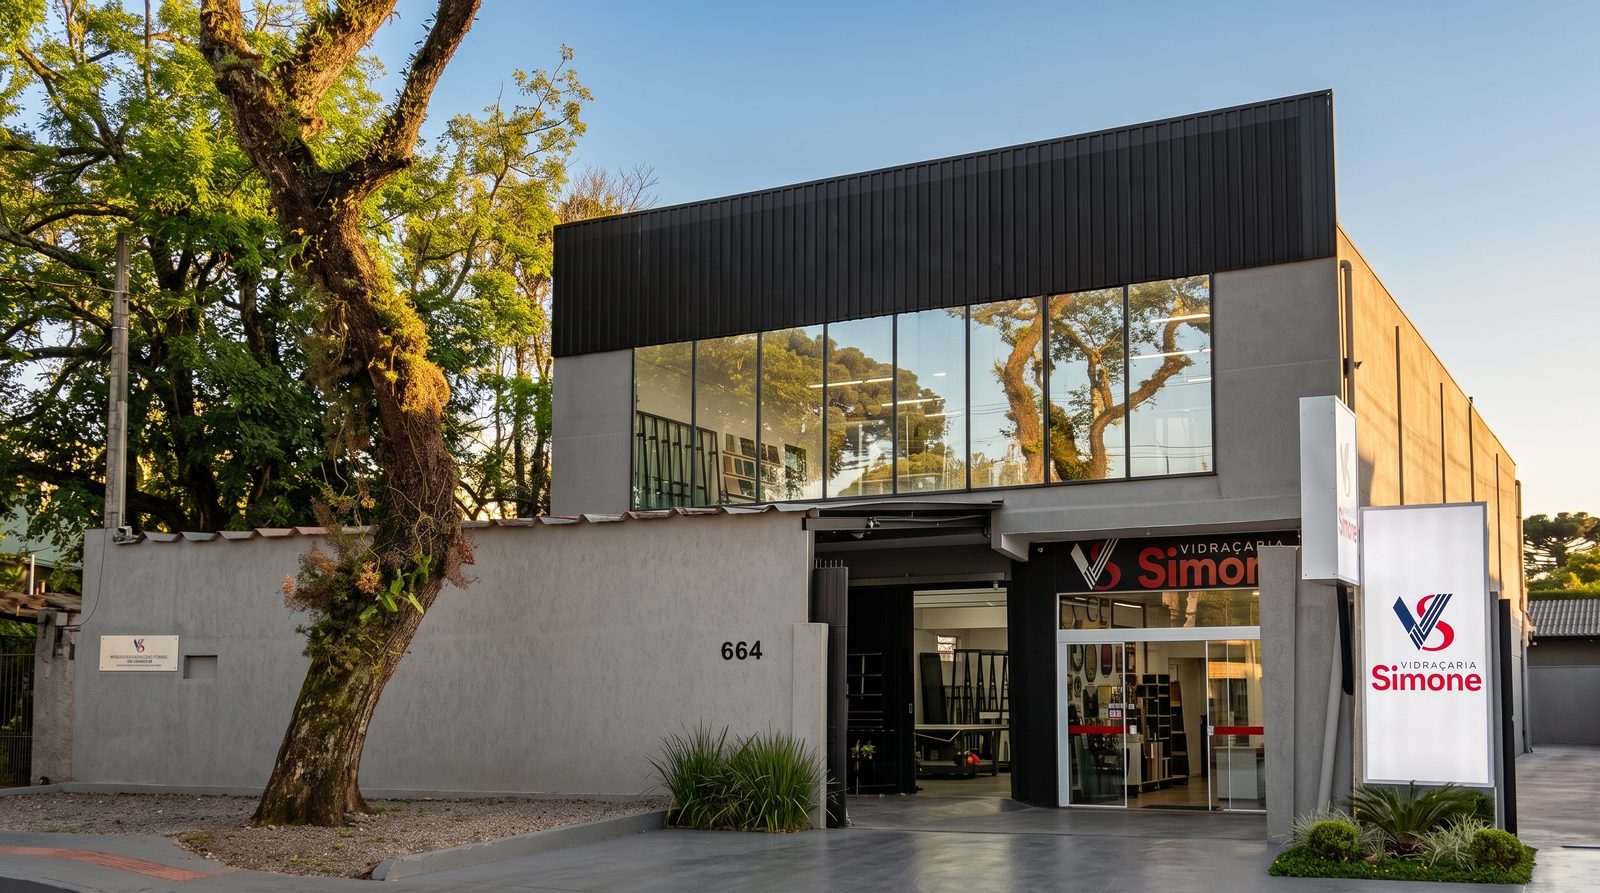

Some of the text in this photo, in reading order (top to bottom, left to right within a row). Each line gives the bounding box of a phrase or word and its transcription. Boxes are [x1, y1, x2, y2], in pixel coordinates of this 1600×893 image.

[1138, 547, 1259, 589] Simo
[721, 640, 763, 661] 664
[1371, 664, 1482, 692] Simone
[1400, 661, 1477, 672] VIDRAÇARIA
